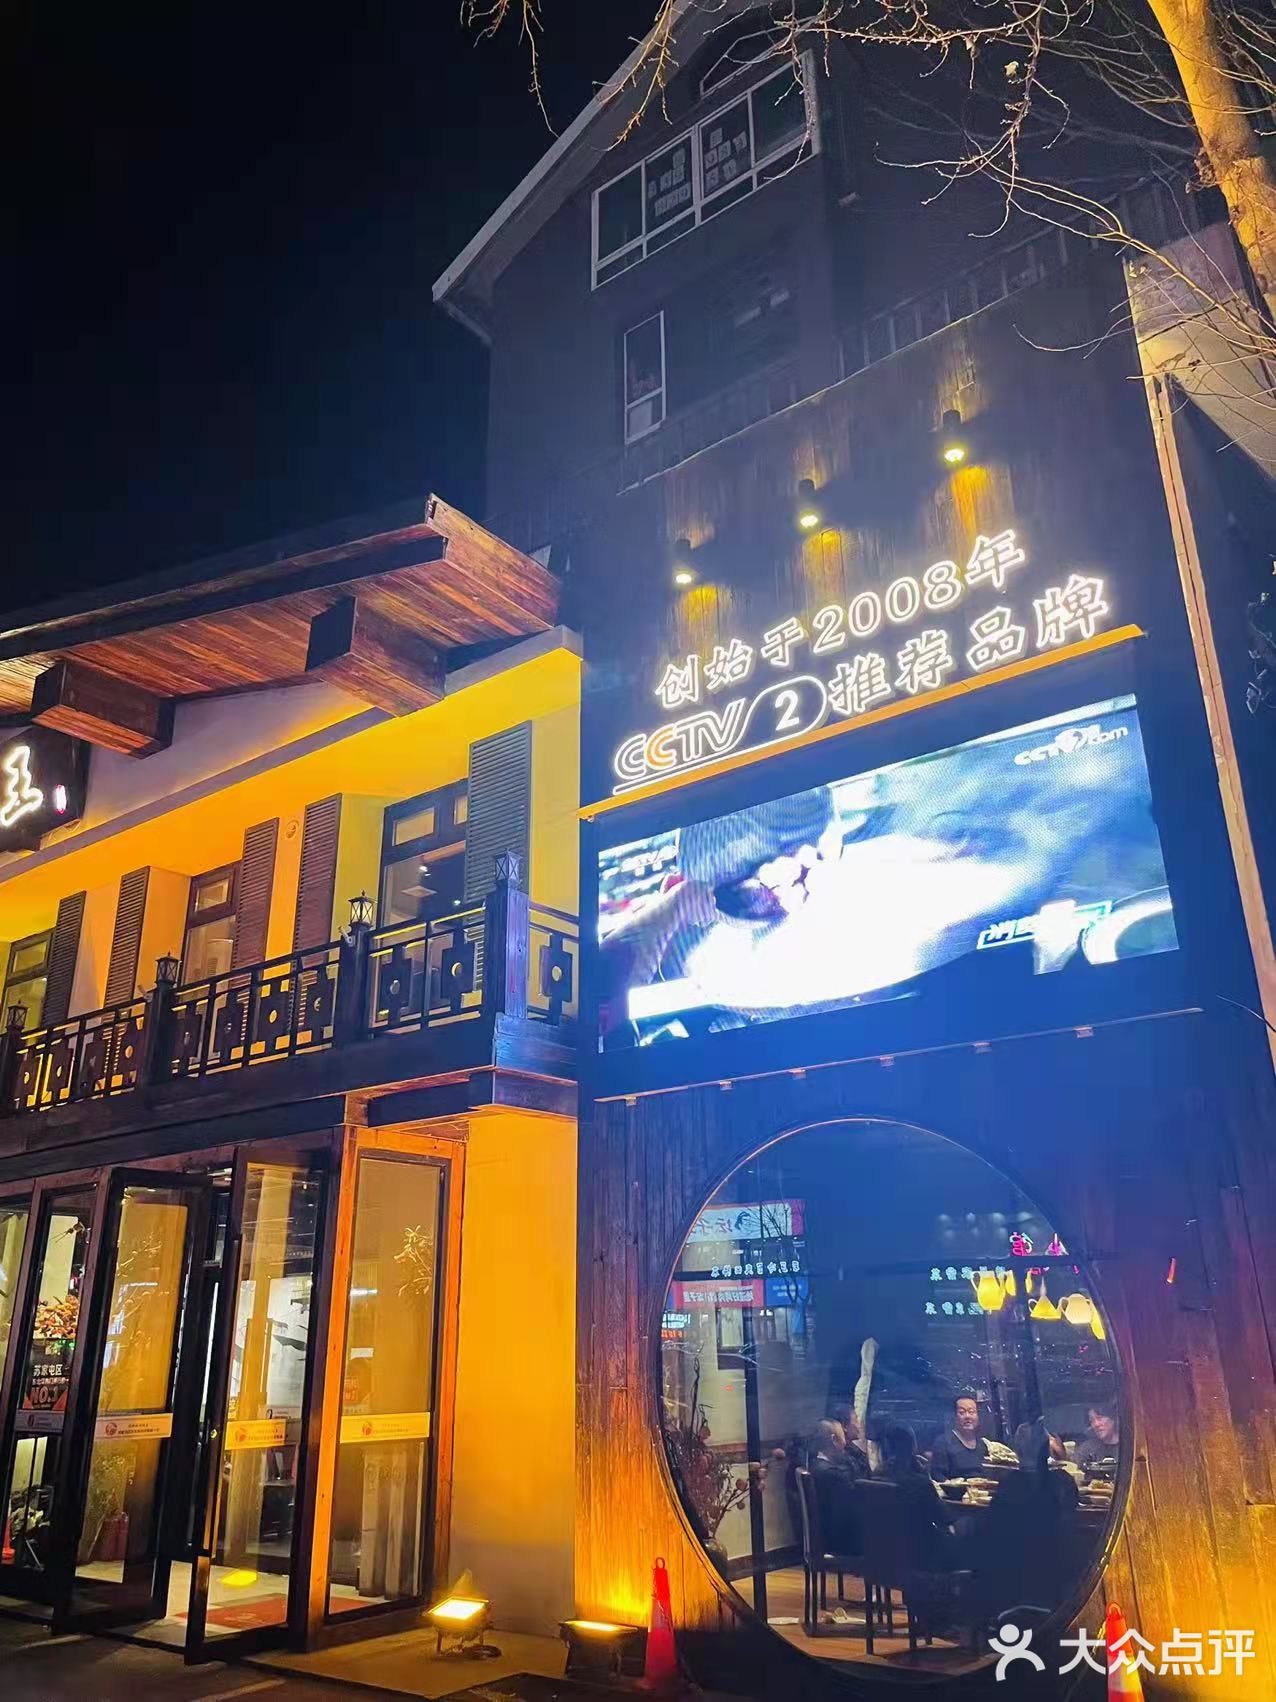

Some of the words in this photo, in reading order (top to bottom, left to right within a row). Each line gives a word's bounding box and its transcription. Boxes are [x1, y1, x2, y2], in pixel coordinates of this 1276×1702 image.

[655, 529, 1026, 709] 创始于2008年
[828, 573, 1109, 716] 推荐品牌
